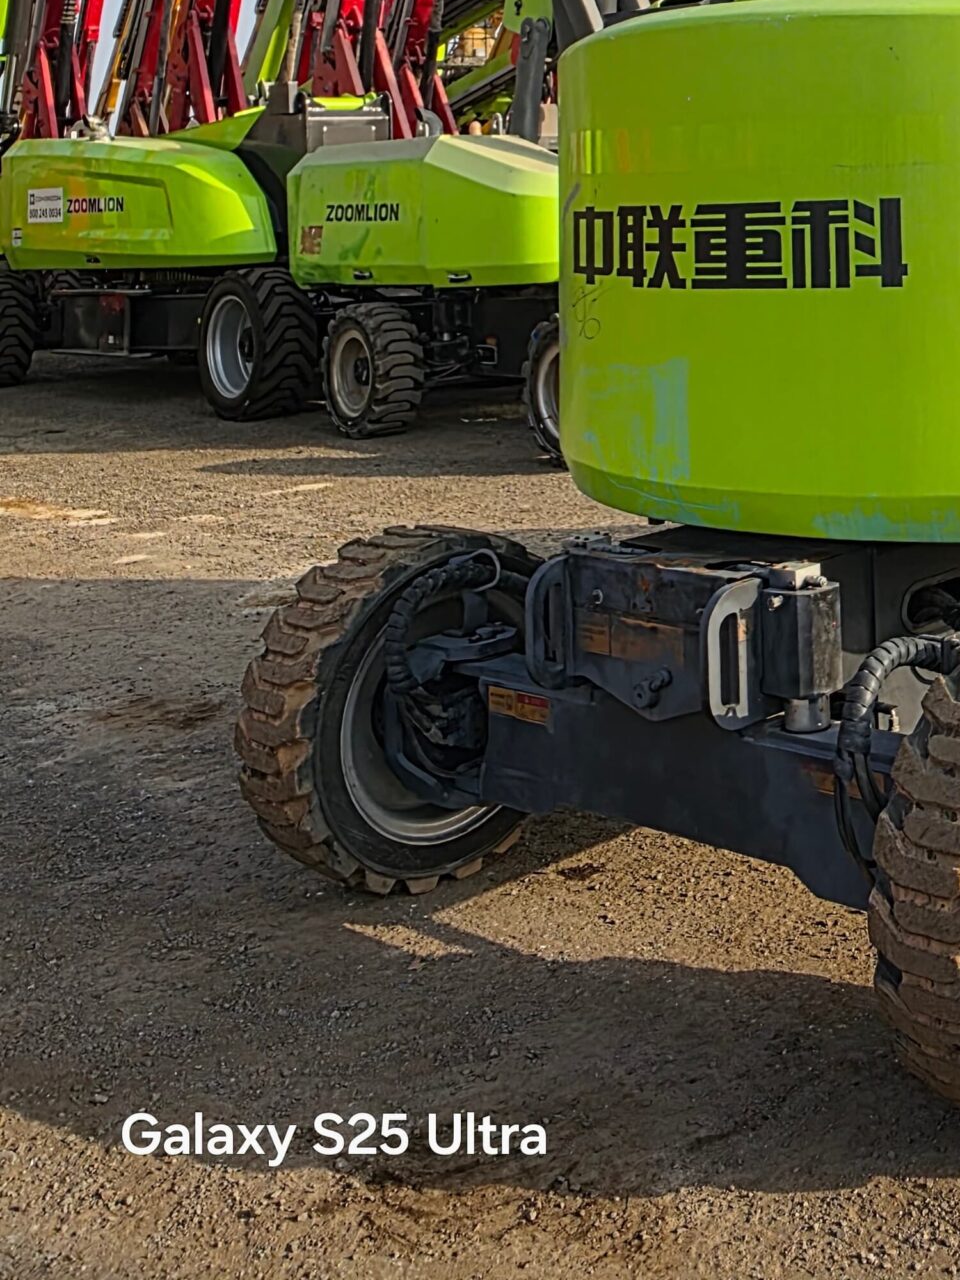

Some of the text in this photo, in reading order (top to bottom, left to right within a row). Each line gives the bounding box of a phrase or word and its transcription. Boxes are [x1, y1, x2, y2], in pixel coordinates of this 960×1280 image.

[66, 196, 125, 214] ZOOMLION
[325, 202, 400, 222] ZOOMLION
[573, 197, 908, 290] 中联重科
